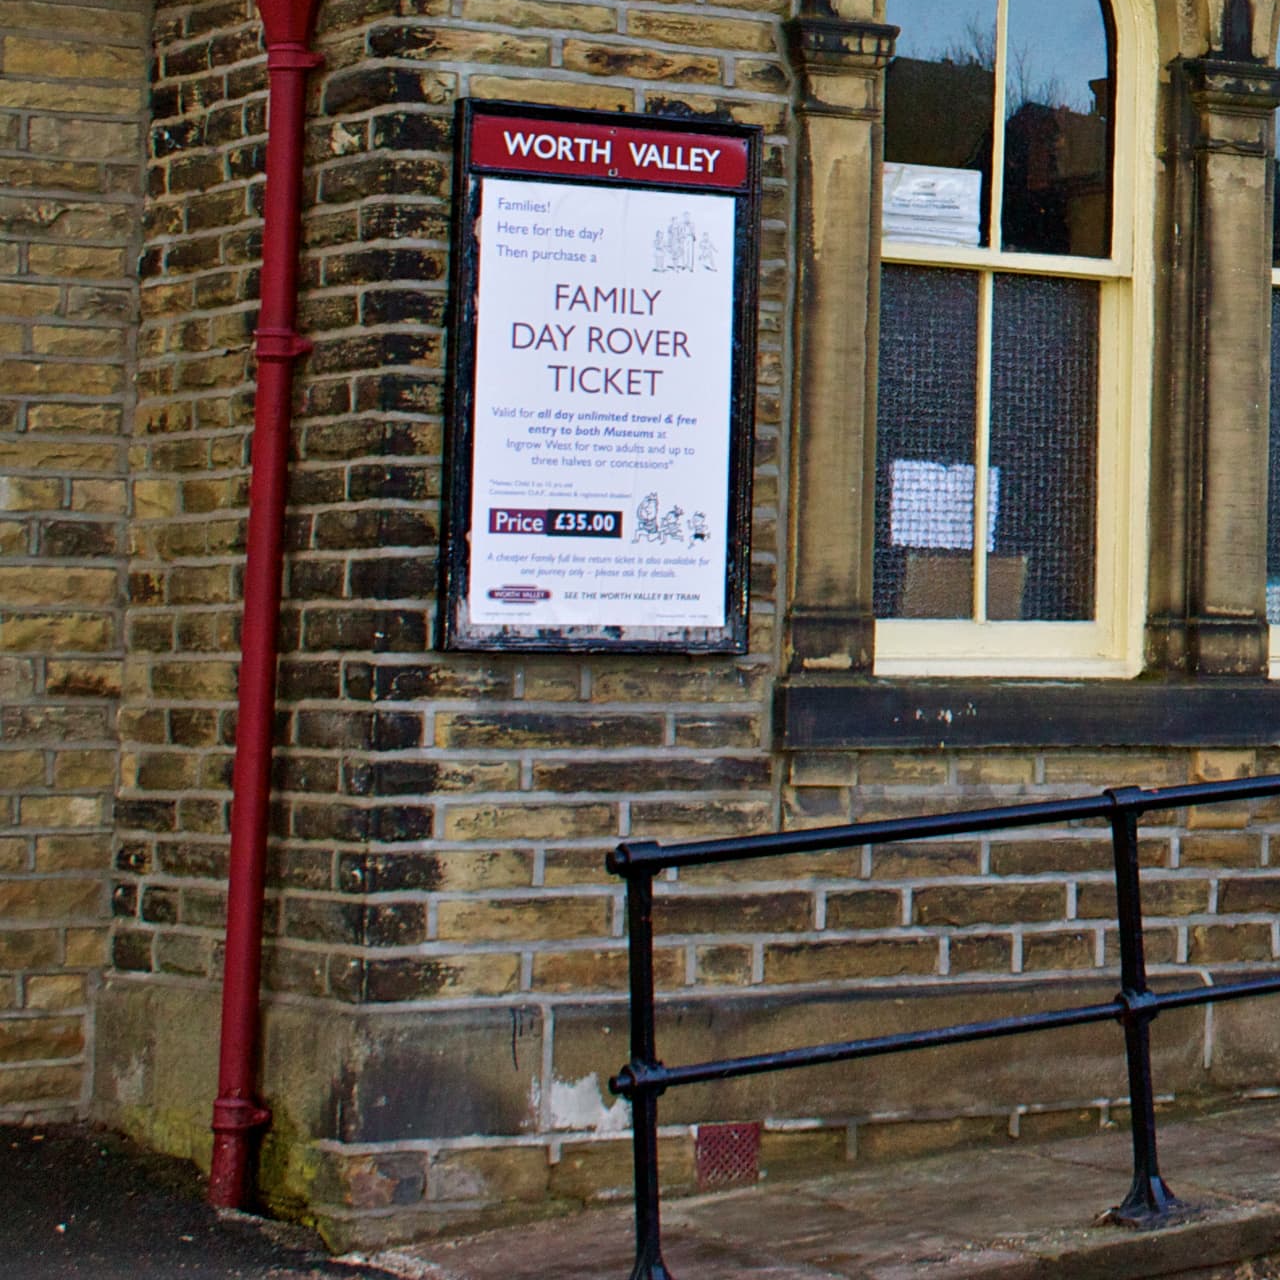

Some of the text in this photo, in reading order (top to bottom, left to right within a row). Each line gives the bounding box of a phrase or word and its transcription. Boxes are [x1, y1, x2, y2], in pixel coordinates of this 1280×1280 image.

[503, 131, 721, 173] WORTH VALLEY
[498, 198, 551, 213] Families!
[497, 222, 605, 243] Here for the day?
[496, 244, 597, 264] Then purchase a
[555, 284, 662, 316] FAMILY
[511, 322, 691, 358] DAY ROVER
[547, 365, 664, 397] TICKET
[492, 407, 697, 427] Valid for all day unlimited travel & free
[528, 426, 667, 439] entry to both Museums at
[506, 438, 695, 456] Ingrow West for two adults and up to
[531, 456, 558, 466] three
[561, 457, 592, 467] halves
[594, 459, 608, 468] or
[495, 511, 615, 533] Price £35.00
[522, 591, 545, 599] VALLEY
[581, 592, 597, 600] THE
[600, 592, 632, 600] WORTH
[633, 592, 662, 601] VALLEY
[676, 592, 701, 601] TRAIN
